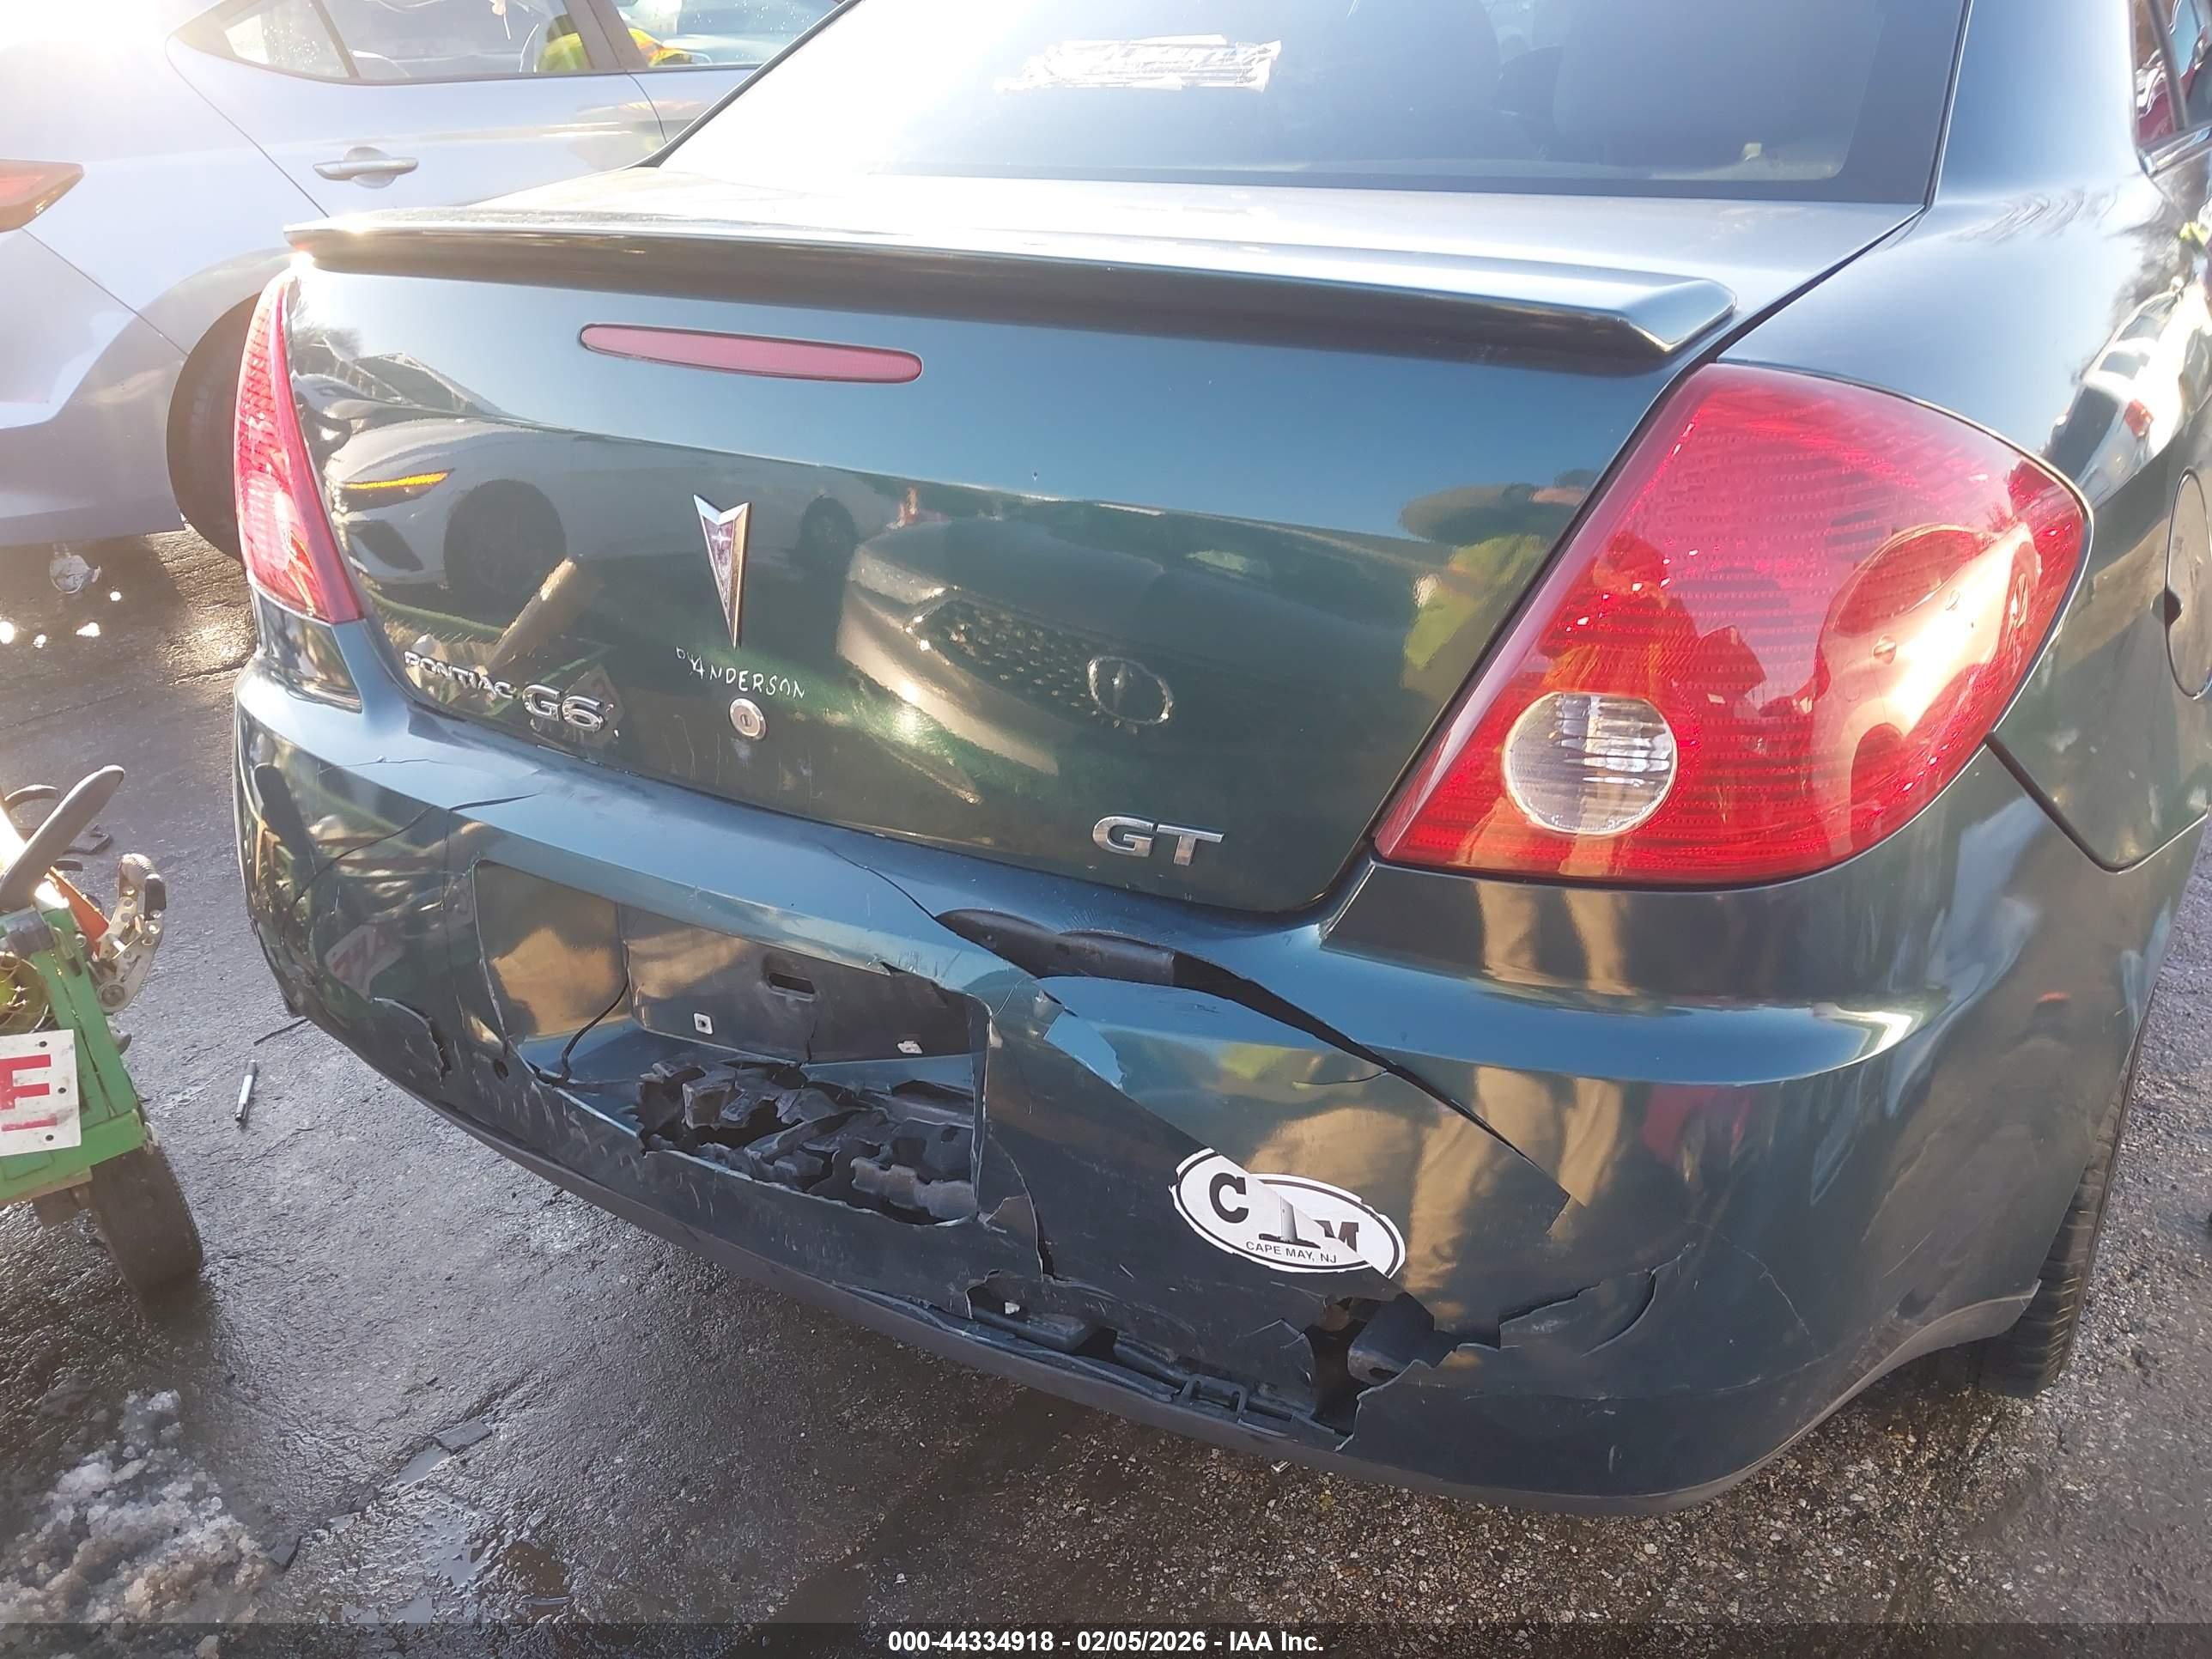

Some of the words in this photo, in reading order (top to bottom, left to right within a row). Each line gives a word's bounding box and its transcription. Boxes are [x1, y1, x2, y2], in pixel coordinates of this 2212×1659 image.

[404, 650, 517, 700] PONTIAC
[522, 684, 606, 732] G6
[1092, 815, 1225, 867] GT
[1245, 1241, 1282, 1255] CAPE
[1285, 1248, 1315, 1262] MAY,
[1320, 1252, 1337, 1263] NJ
